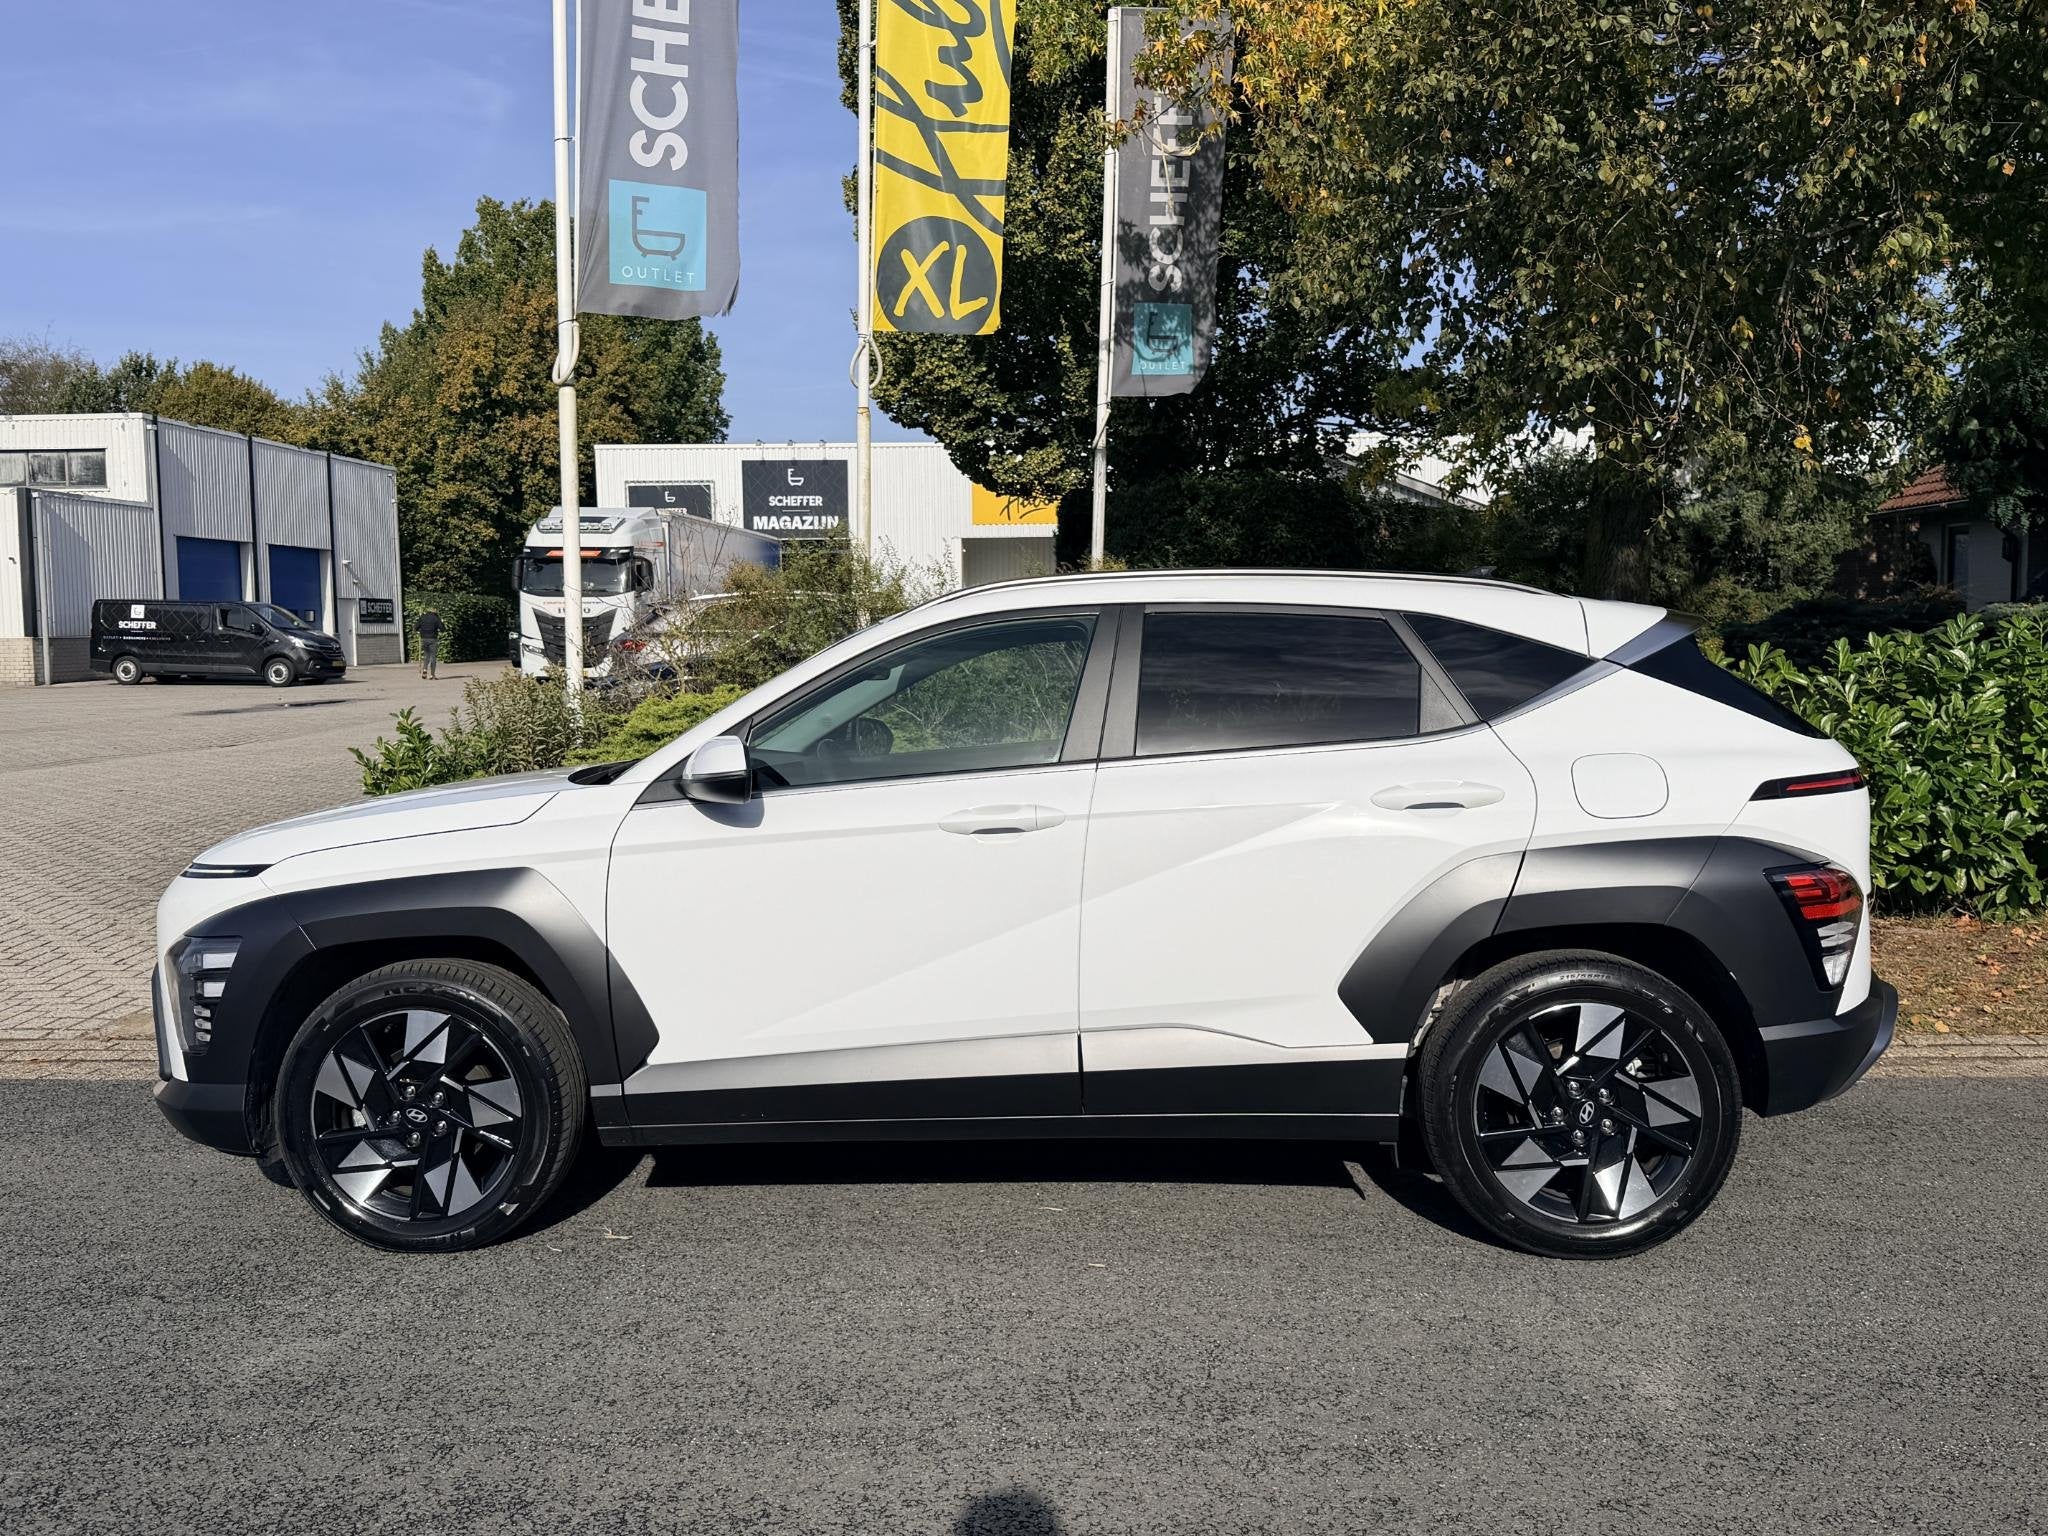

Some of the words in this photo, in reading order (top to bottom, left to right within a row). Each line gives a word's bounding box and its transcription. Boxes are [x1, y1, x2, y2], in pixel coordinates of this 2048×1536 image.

[621, 264, 696, 284] OUTLET
[893, 240, 989, 321] XL
[1140, 360, 1186, 371] OUTLET
[768, 495, 823, 507] SCHEFFER
[753, 515, 839, 530] MAGAZIJN
[118, 620, 157, 630] SCHEFFER
